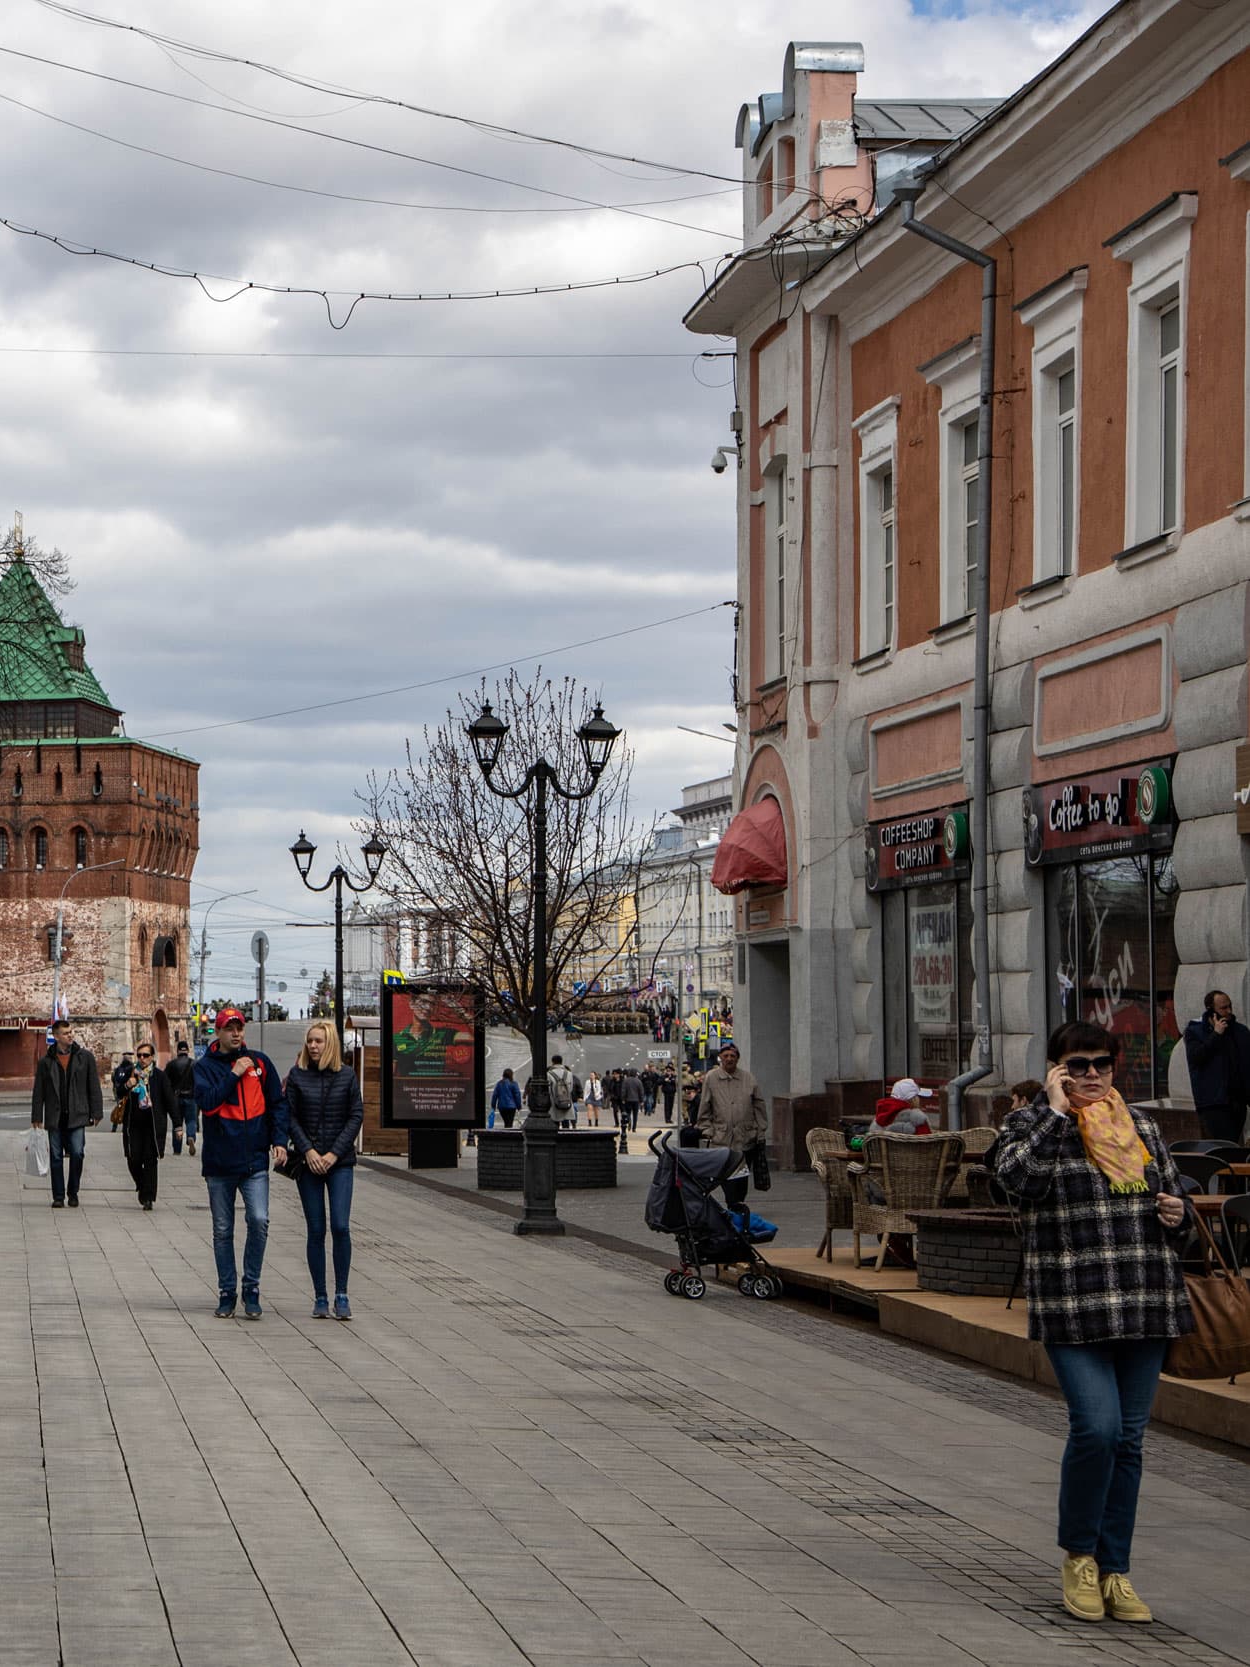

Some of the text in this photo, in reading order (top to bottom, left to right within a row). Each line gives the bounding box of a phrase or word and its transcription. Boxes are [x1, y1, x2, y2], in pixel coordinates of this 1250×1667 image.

[1049, 785, 1084, 832] Coffee
[1088, 793, 1100, 822] to
[1105, 778, 1123, 826] go!
[880, 818, 934, 847] COFFEESHOP
[894, 844, 935, 870] COMPANY
